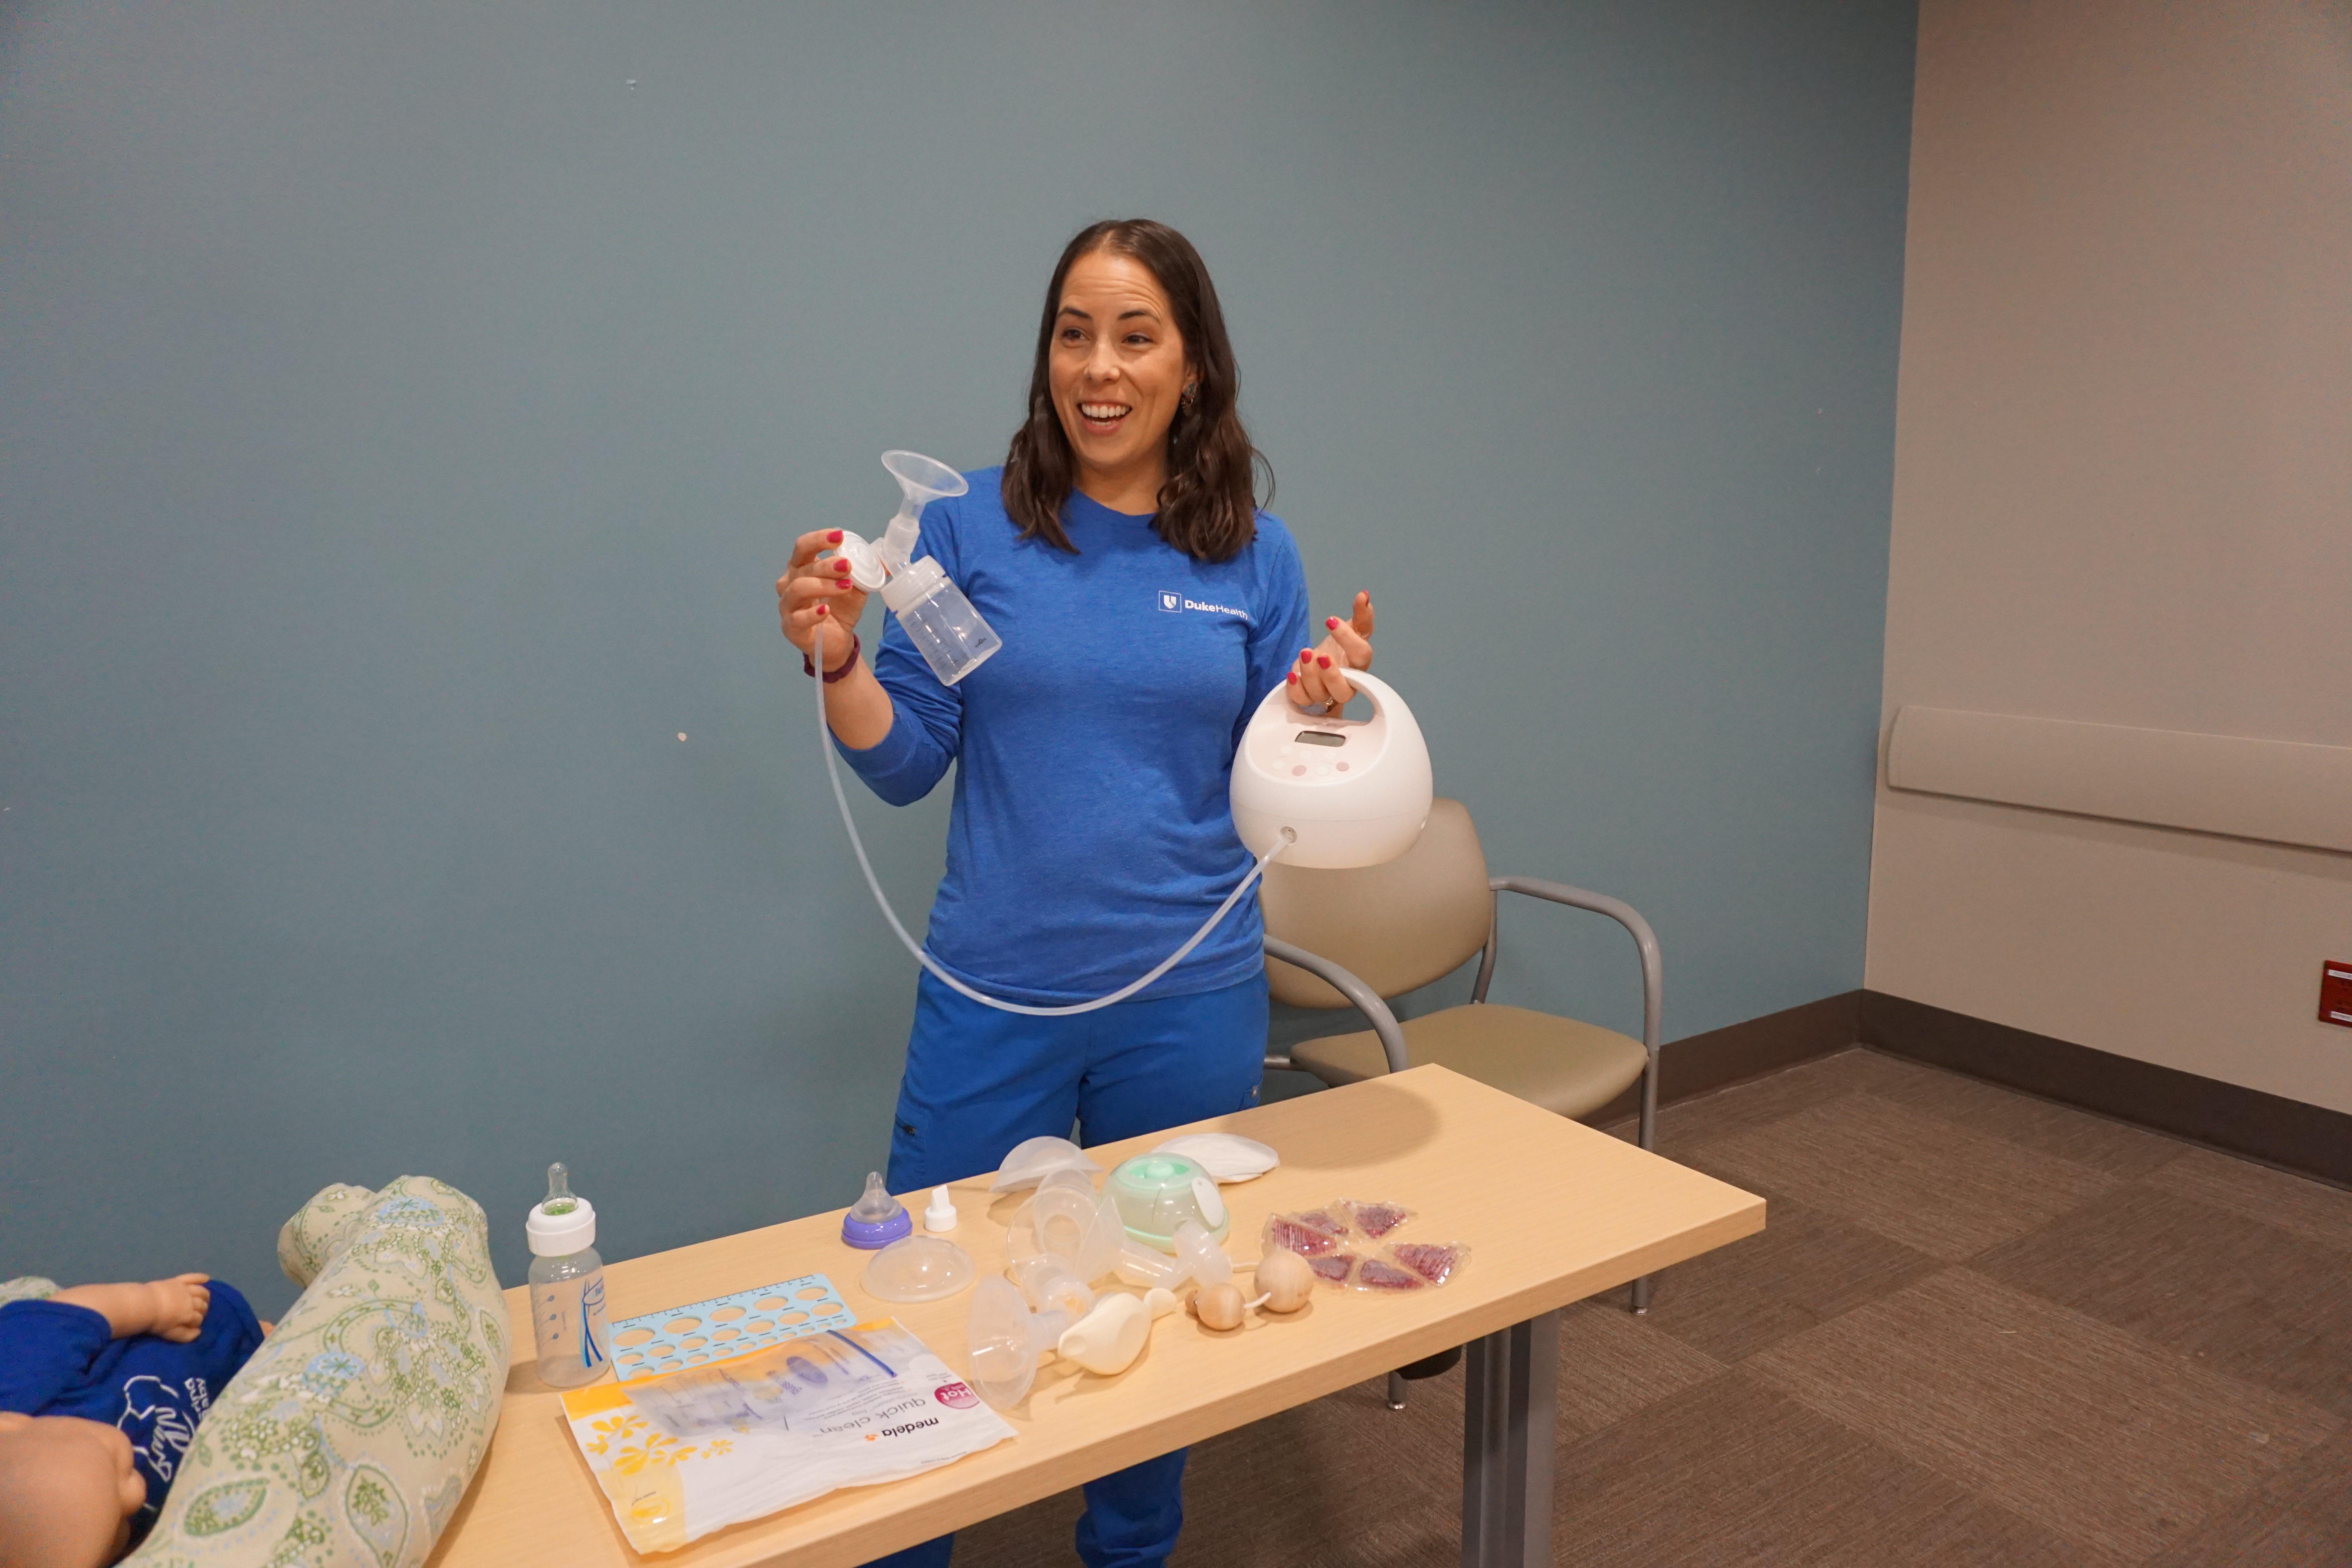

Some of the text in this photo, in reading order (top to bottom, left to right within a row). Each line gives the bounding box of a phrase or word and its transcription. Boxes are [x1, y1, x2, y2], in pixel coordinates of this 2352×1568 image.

[1185, 600, 1248, 620] DukeHealth
[940, 1388, 971, 1400] Hot
[875, 1398, 926, 1419] quick
[882, 1417, 939, 1437] medela
